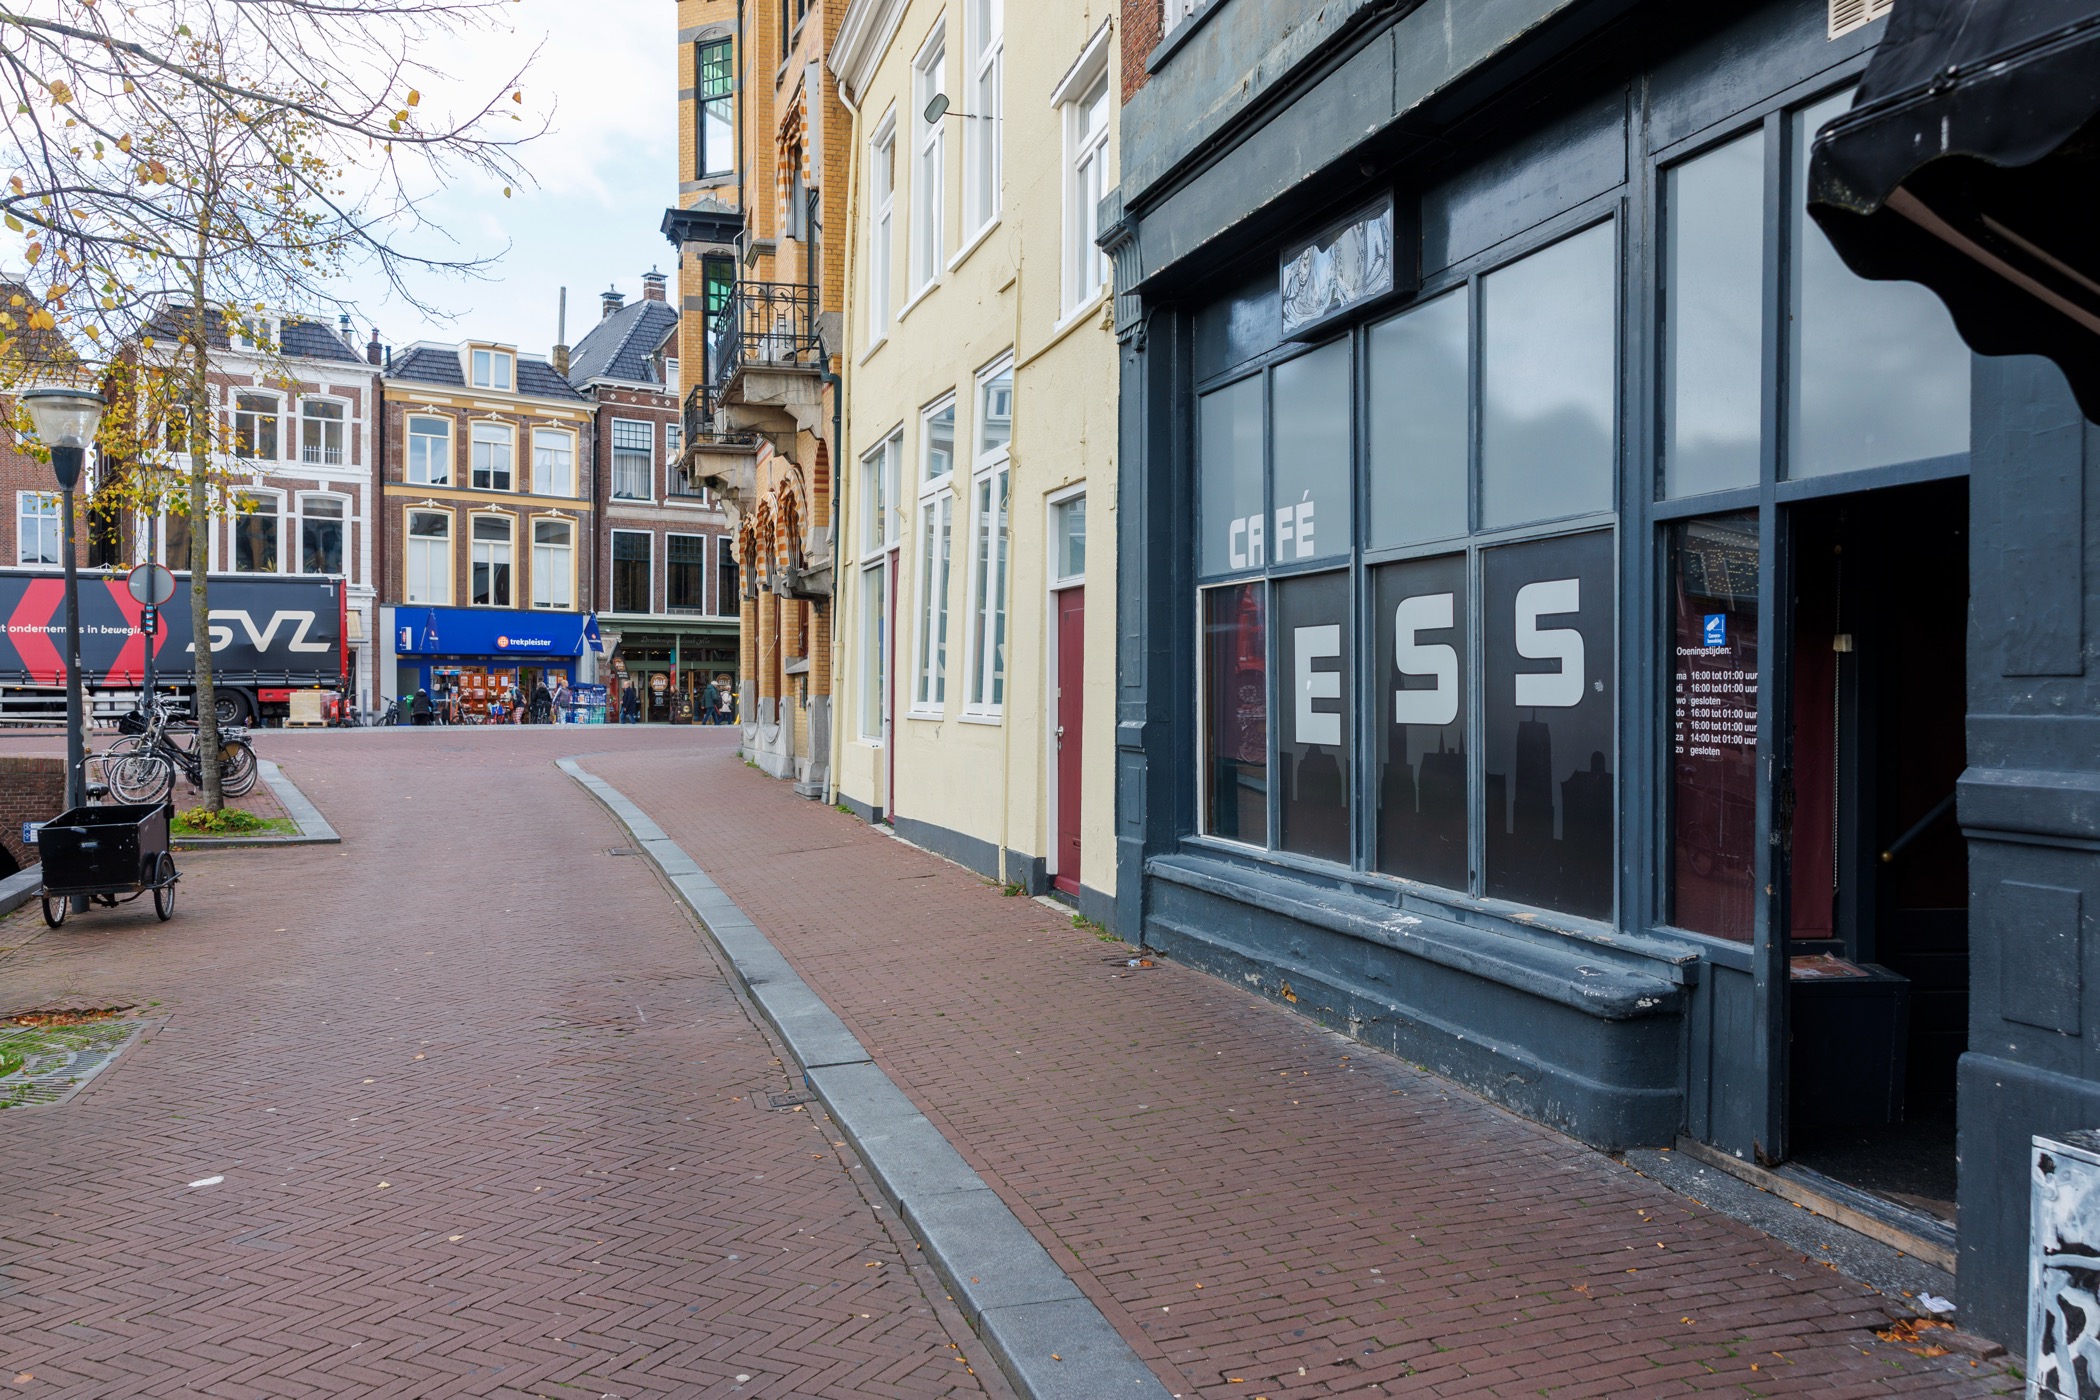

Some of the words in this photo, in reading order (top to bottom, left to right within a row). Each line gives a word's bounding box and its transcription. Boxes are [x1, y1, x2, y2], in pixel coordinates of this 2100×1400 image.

[1229, 490, 1314, 569] CAFÉ
[9, 624, 84, 633] ondernems
[88, 624, 98, 633] in
[101, 625, 147, 636] bewegin
[186, 610, 331, 652] SVZ
[510, 638, 551, 647] trekpleister
[1294, 578, 1585, 746] ESS
[1691, 671, 1710, 680] 16:00
[1712, 671, 1722, 680] tot
[1723, 671, 1744, 680] 01:00
[1676, 684, 1683, 692] di
[1691, 684, 1710, 692] 16:00
[1712, 684, 1722, 692] tot
[1723, 684, 1744, 692] 01:00
[1691, 696, 1721, 706] gesloten
[1676, 708, 1685, 716] do
[1691, 708, 1710, 717] 16:00
[1711, 709, 1721, 718] tot
[1723, 709, 1743, 718] 01:00
[1745, 711, 1757, 719] uur
[1691, 721, 1710, 729] 16:00
[1711, 721, 1721, 730] tot
[1722, 721, 1743, 731] 01:00
[1690, 733, 1710, 742] 14:00
[1711, 734, 1721, 743] tot
[1722, 734, 1743, 744] 01:00
[1744, 737, 1757, 745] uur
[1690, 746, 1720, 756] gesloten
